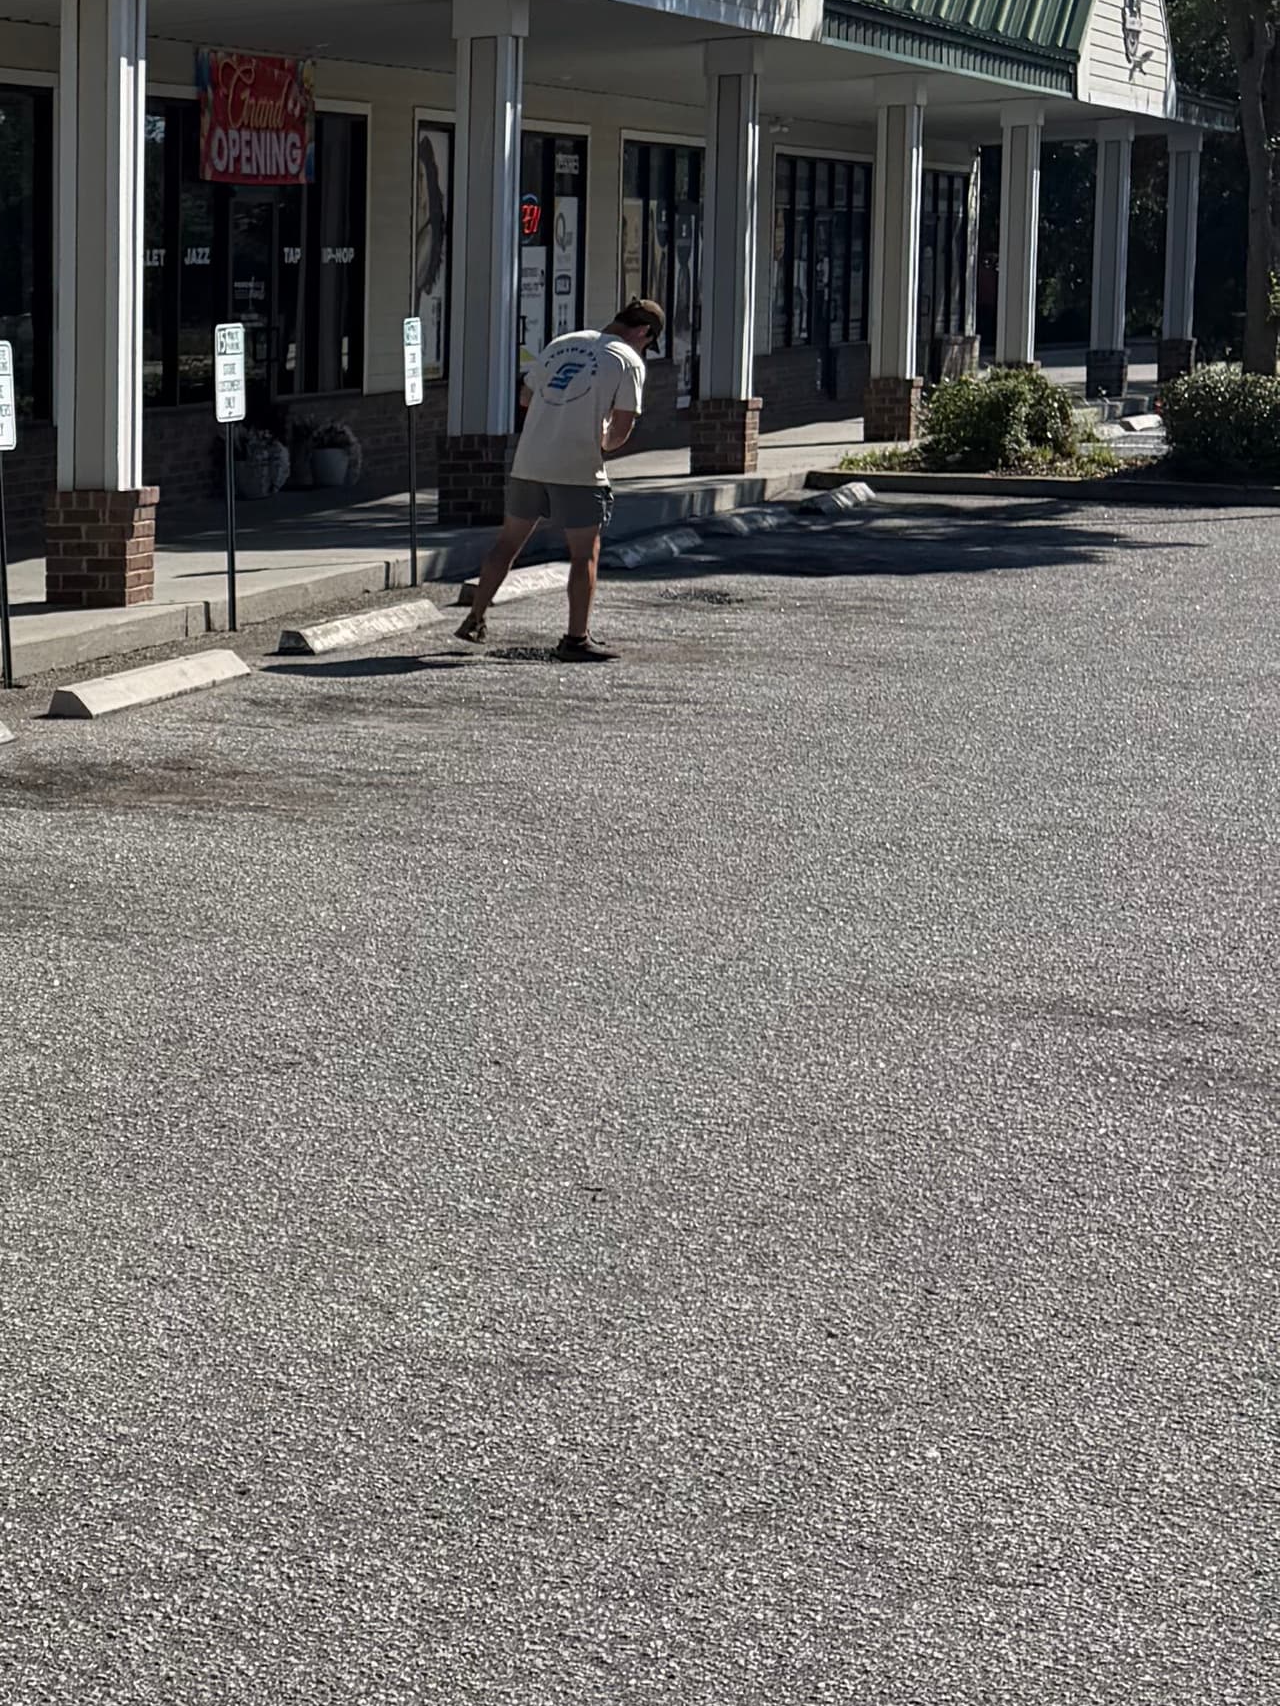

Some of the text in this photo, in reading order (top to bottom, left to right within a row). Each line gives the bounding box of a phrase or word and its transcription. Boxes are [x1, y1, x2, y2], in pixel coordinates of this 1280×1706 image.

[219, 57, 293, 130] Grand
[211, 129, 304, 176] OPENING
[183, 246, 211, 267] JAZZ
[283, 246, 302, 264] TAP
